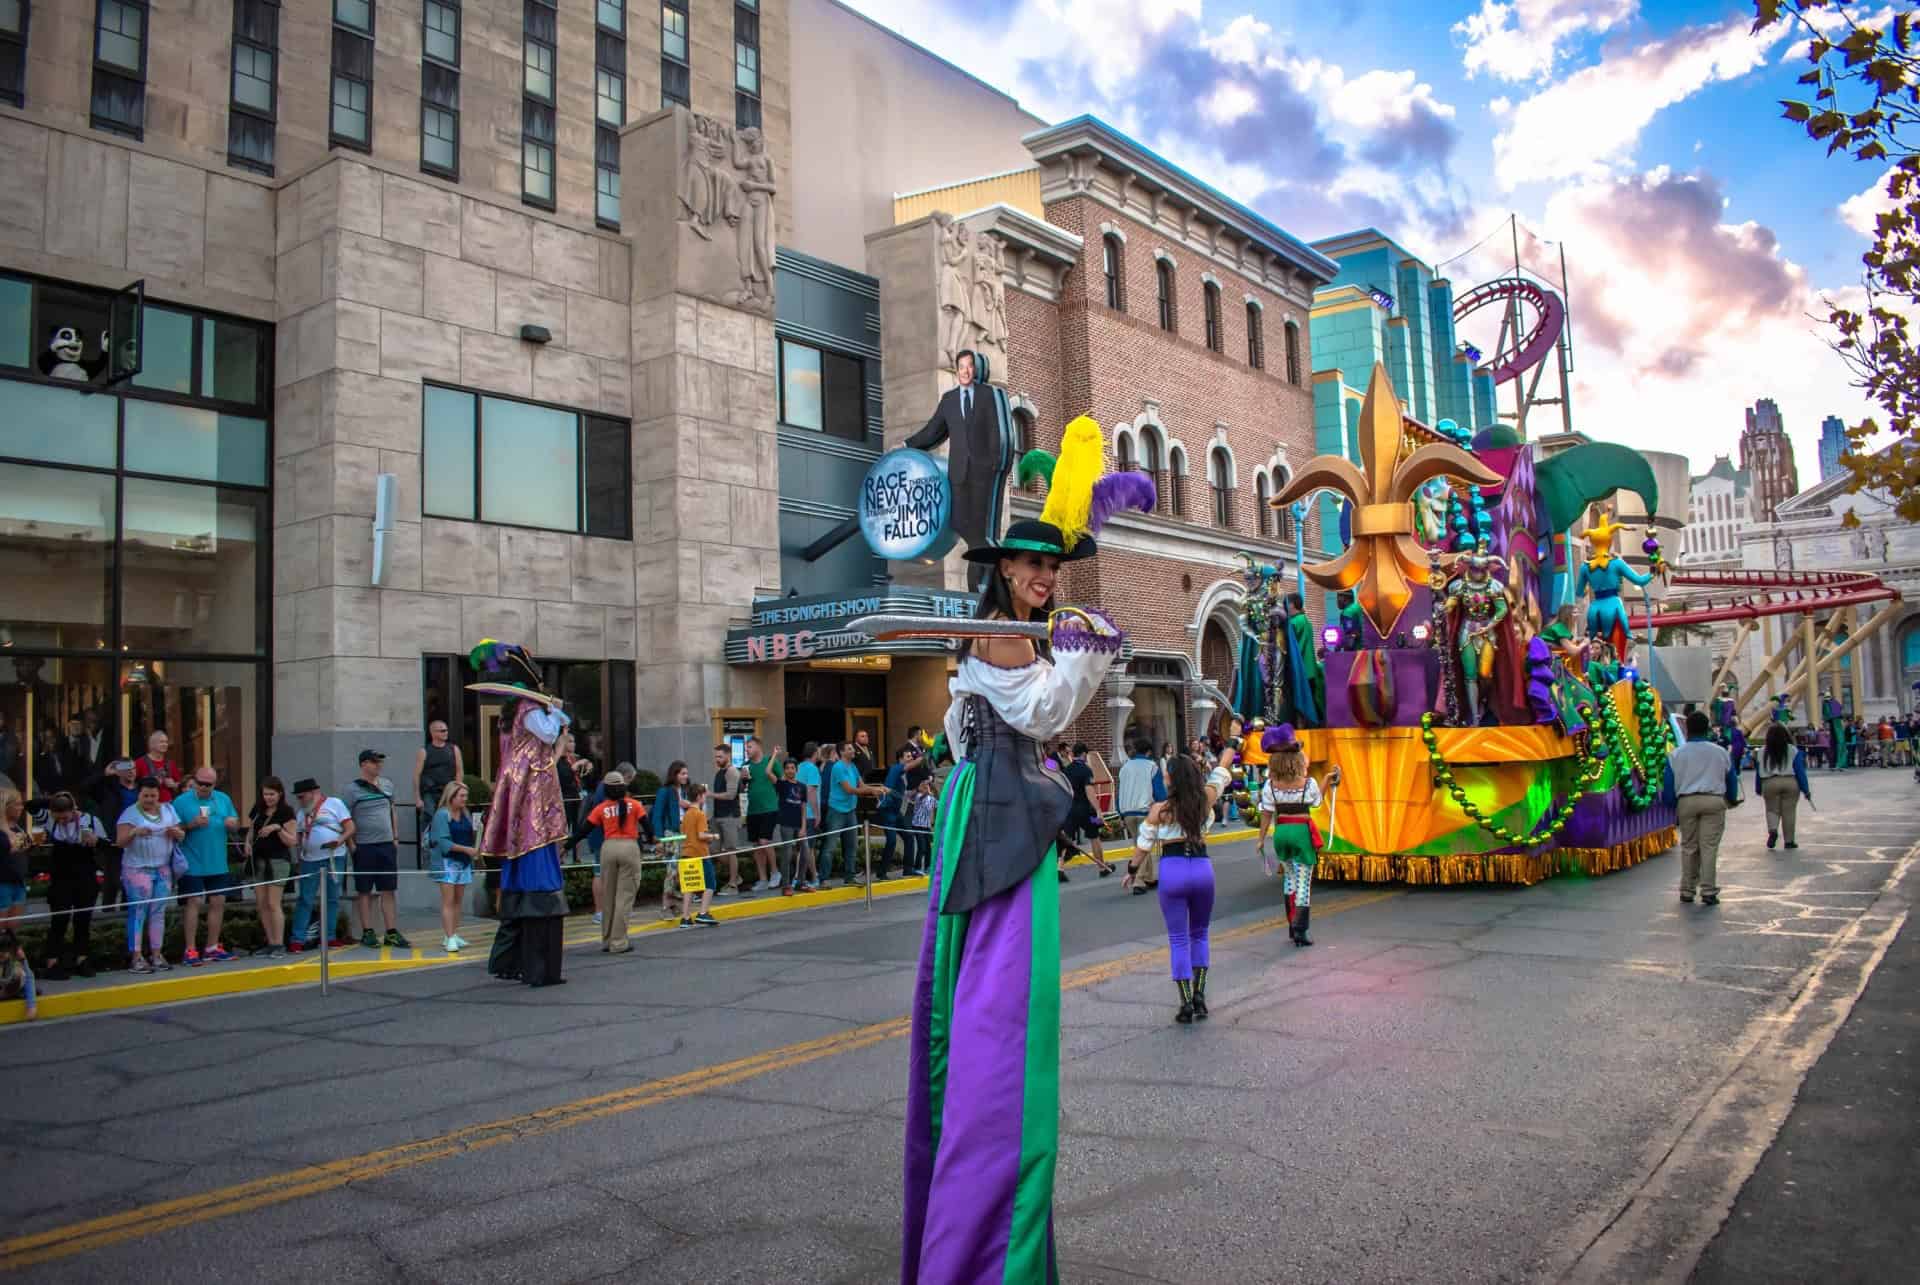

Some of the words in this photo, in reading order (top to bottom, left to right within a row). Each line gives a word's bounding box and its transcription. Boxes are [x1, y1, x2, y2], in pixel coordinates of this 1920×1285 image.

[865, 471, 907, 492] RACE
[866, 487, 900, 513] NEW
[904, 482, 944, 504] YORK
[894, 499, 944, 524] JIMMY
[884, 518, 940, 541] FALLON
[760, 608, 782, 625] THE
[785, 602, 837, 621] TONIGHT
[839, 597, 881, 617] SHOW
[932, 595, 968, 618] THE
[747, 630, 816, 662] NBC
[819, 631, 870, 649] STUDIOS
[603, 802, 633, 818] STF
